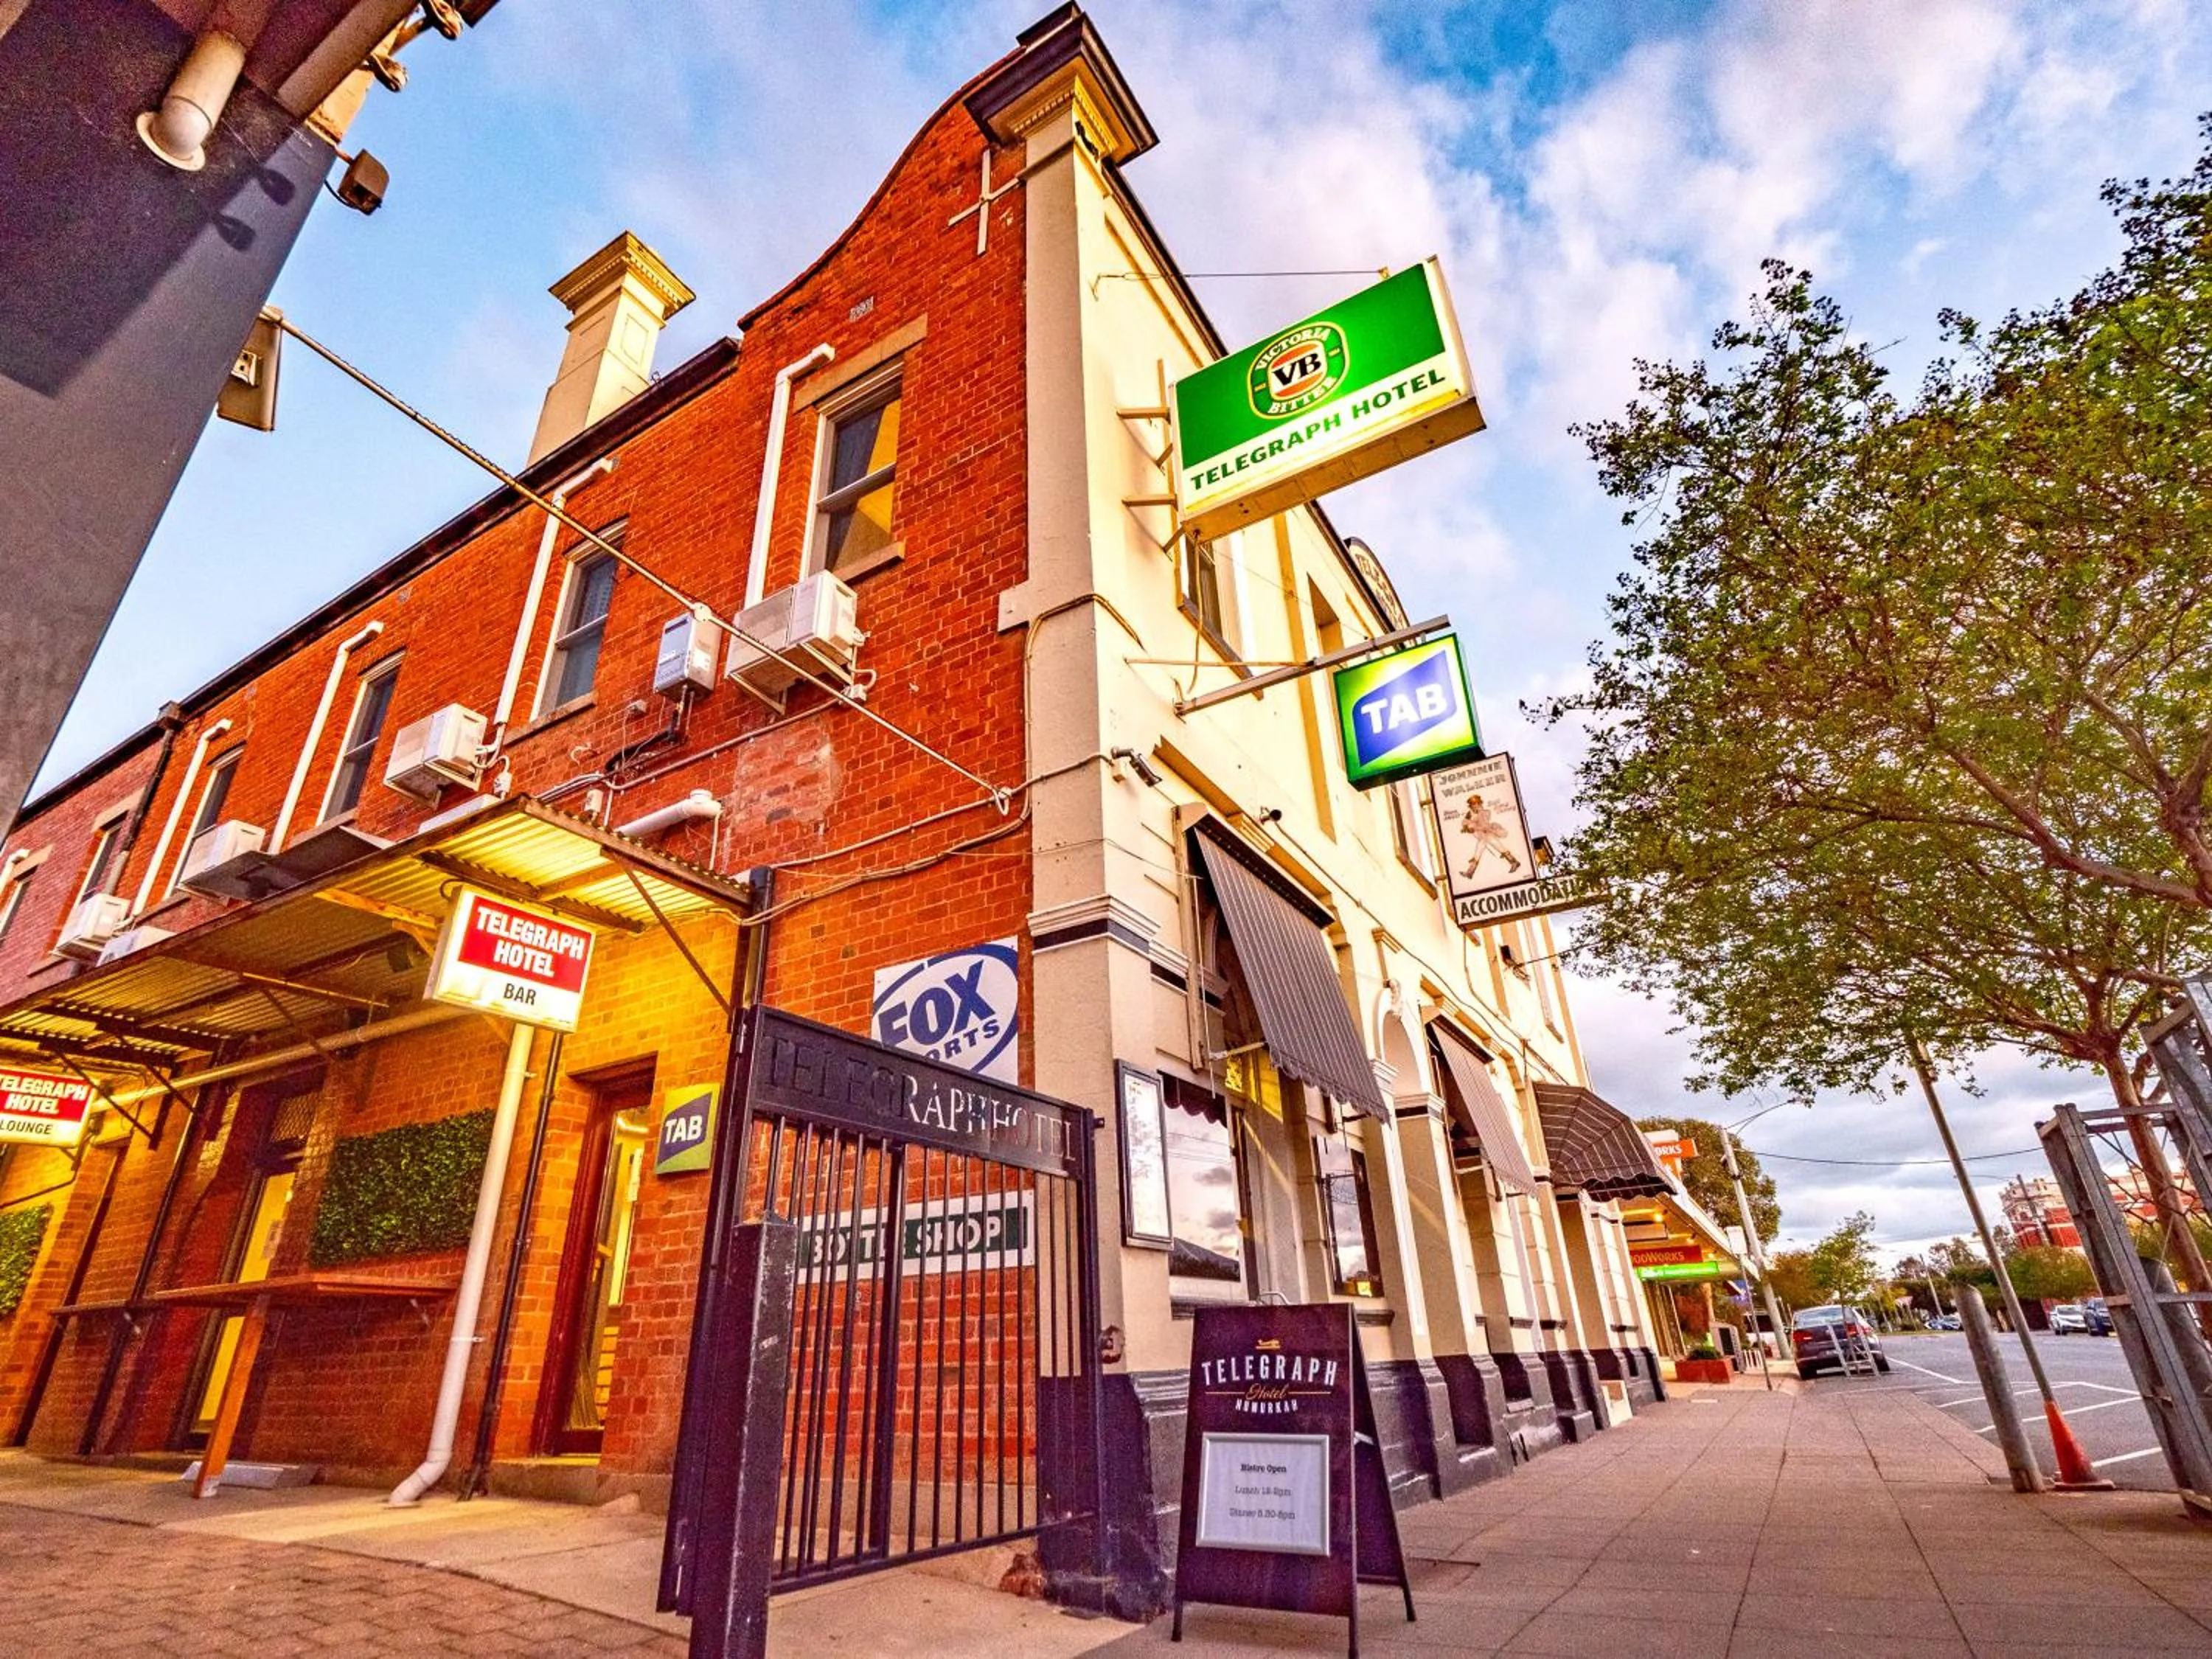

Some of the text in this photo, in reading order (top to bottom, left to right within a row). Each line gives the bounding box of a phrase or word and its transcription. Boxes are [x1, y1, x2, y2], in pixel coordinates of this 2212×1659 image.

[1255, 327, 1331, 370] VICTORIA
[1271, 353, 1321, 386] VB
[1267, 377, 1337, 414] BITTER
[1190, 369, 1447, 491] TELEGRAPH HOTEL
[1360, 683, 1448, 734] TAB
[1439, 760, 1503, 785] JOHNNIE
[1441, 773, 1506, 798] WALKER
[476, 906, 585, 960] TELEGRAPH
[493, 940, 554, 978] HOTEL
[503, 982, 537, 1006] BAR
[878, 959, 996, 1047] FOX
[4, 1093, 60, 1115] HOTEL
[0, 1119, 53, 1135] LOUNGE
[665, 1115, 703, 1144] TAB
[990, 1097, 1076, 1162] HOTEL
[915, 1217, 1002, 1255] SHOP
[1201, 1354, 1338, 1386] TELEGRAPH
[1235, 1398, 1298, 1414] NUMURKAH
[1245, 1382, 1290, 1400] Hotel
[1240, 1464, 1287, 1474] Bistro Open
[1235, 1486, 1260, 1495] Lunch
